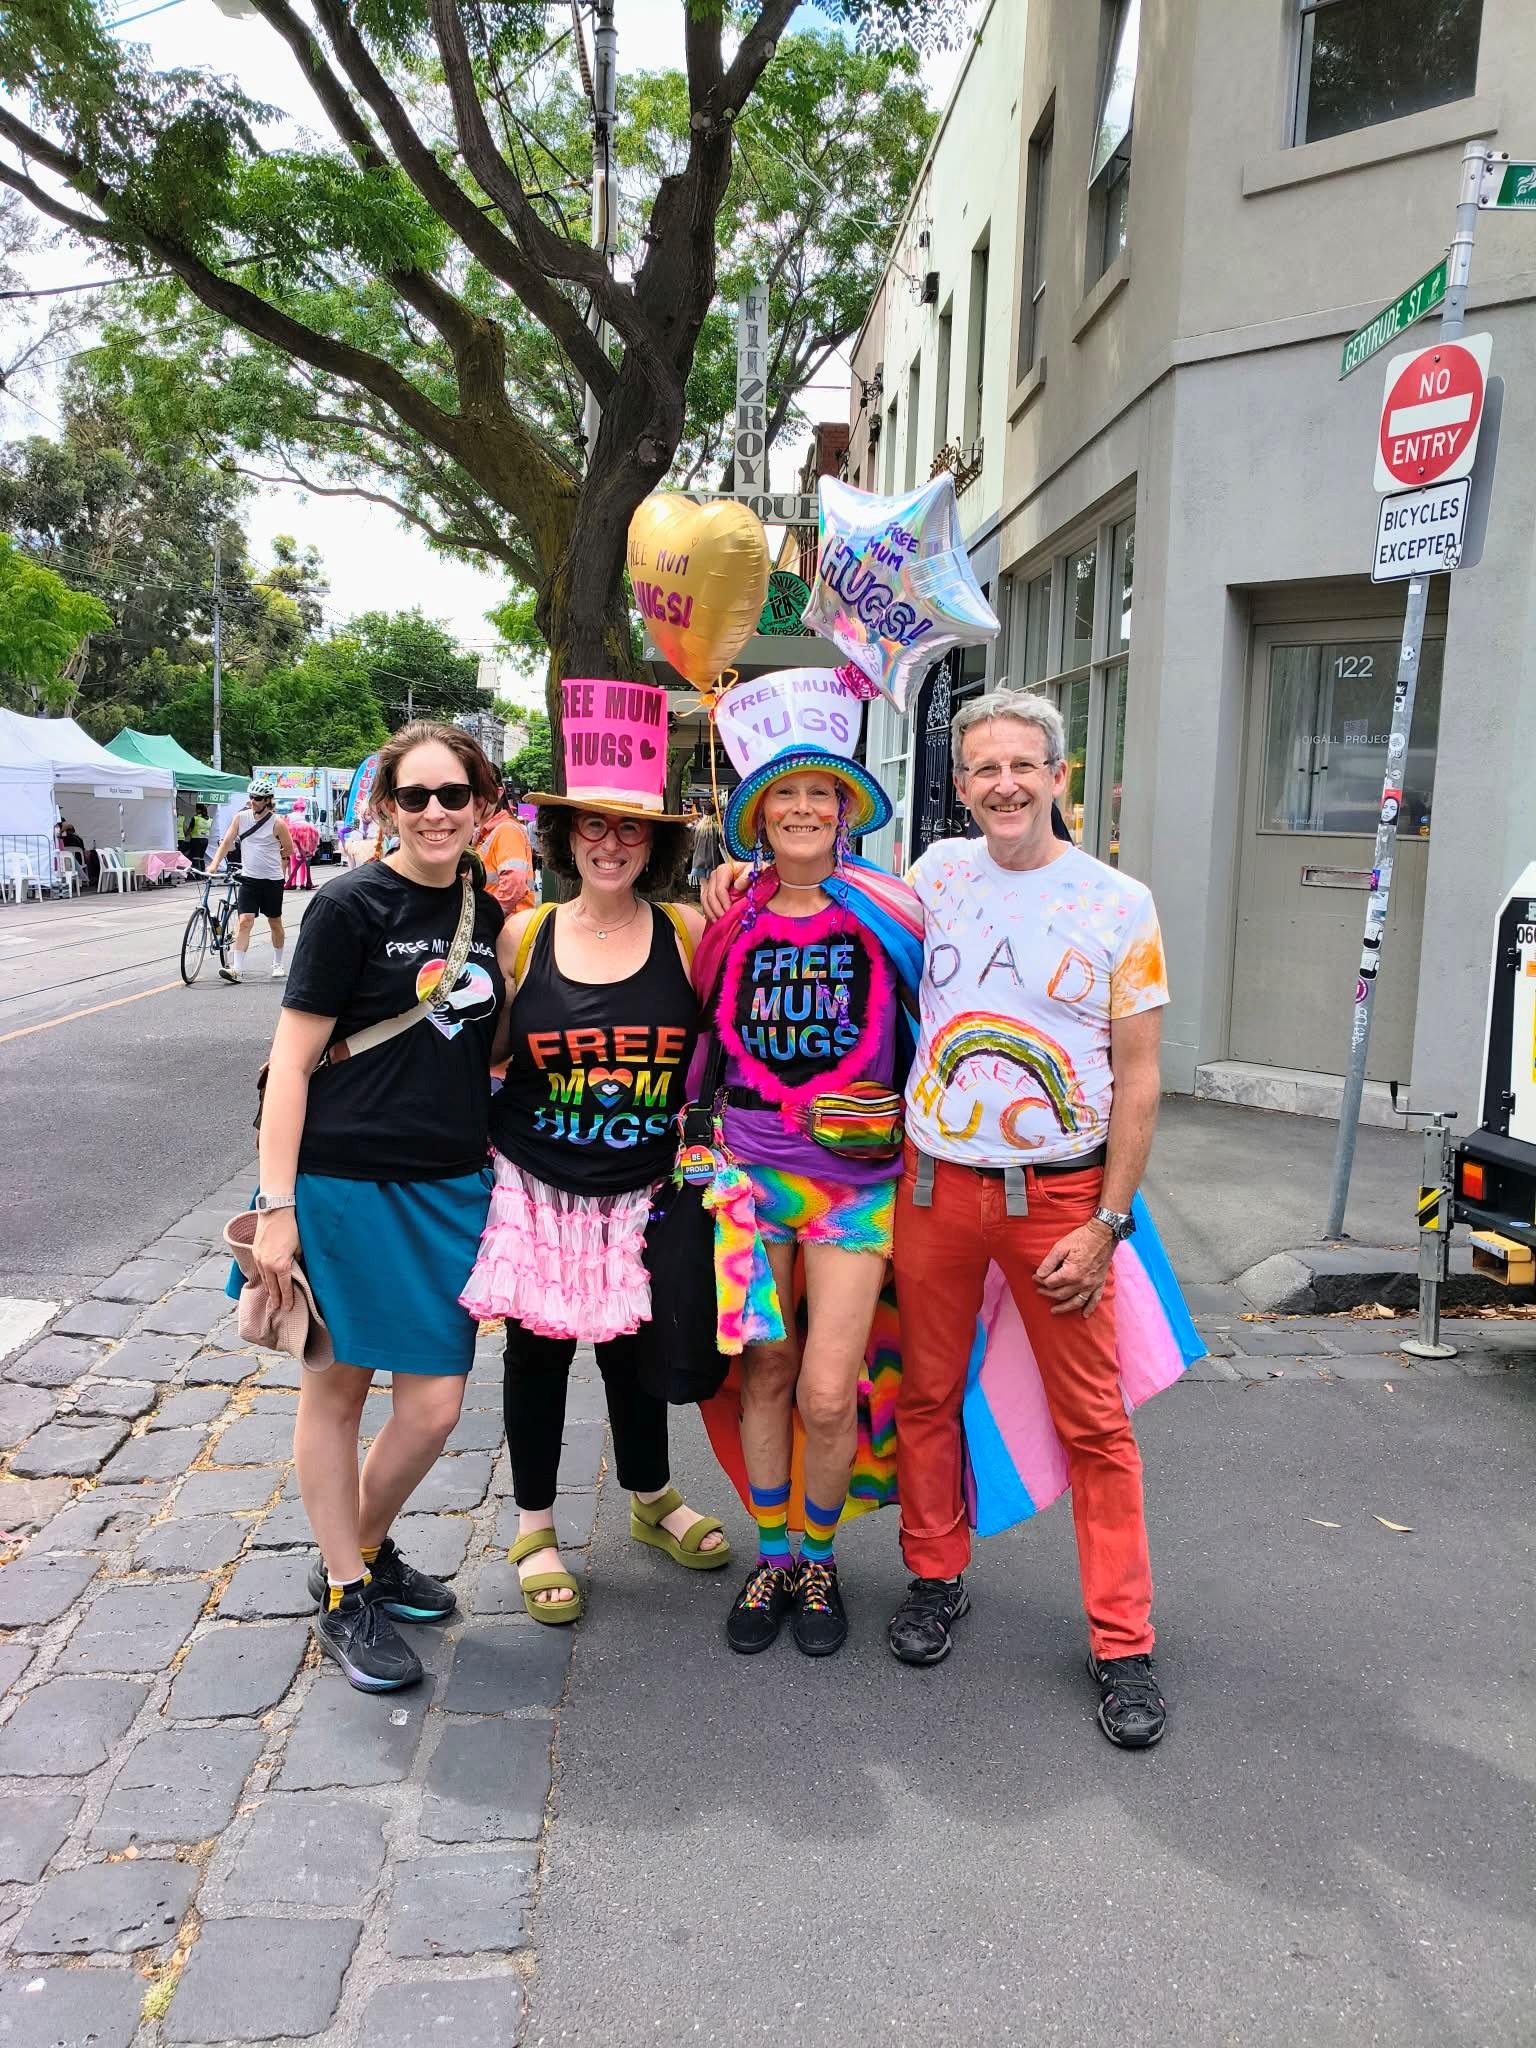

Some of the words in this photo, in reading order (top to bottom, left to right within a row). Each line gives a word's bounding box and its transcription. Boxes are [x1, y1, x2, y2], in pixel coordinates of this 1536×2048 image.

[1345, 300, 1404, 370] GERTRUDE
[1407, 283, 1424, 322] ST
[736, 296, 766, 484] FITZROY
[1419, 369, 1450, 399] NO
[1392, 428, 1462, 466] ENTRY
[684, 495, 819, 521] NIQUE
[1384, 498, 1459, 532] BICYCLES
[864, 536, 904, 572] MUM
[885, 522, 920, 554] FREE
[1379, 533, 1456, 564] EXCEPTED
[656, 549, 690, 577] MUM
[820, 535, 934, 647] HUGS!
[1334, 655, 1374, 679] 122
[605, 686, 663, 728] MUM
[728, 682, 786, 718] FREE
[792, 678, 847, 698] MUM
[571, 732, 633, 769] HUGS
[386, 940, 429, 958] FREE
[469, 942, 495, 958] UGS
[1517, 926, 1536, 944] 06
[752, 945, 855, 982] FREE
[750, 984, 847, 1021] MUM
[527, 1026, 687, 1070] FREE
[742, 1024, 860, 1061] HUGS
[532, 1106, 669, 1149] HUGS
[685, 1165, 710, 1174] PROUD
[691, 1152, 701, 1161] BE
